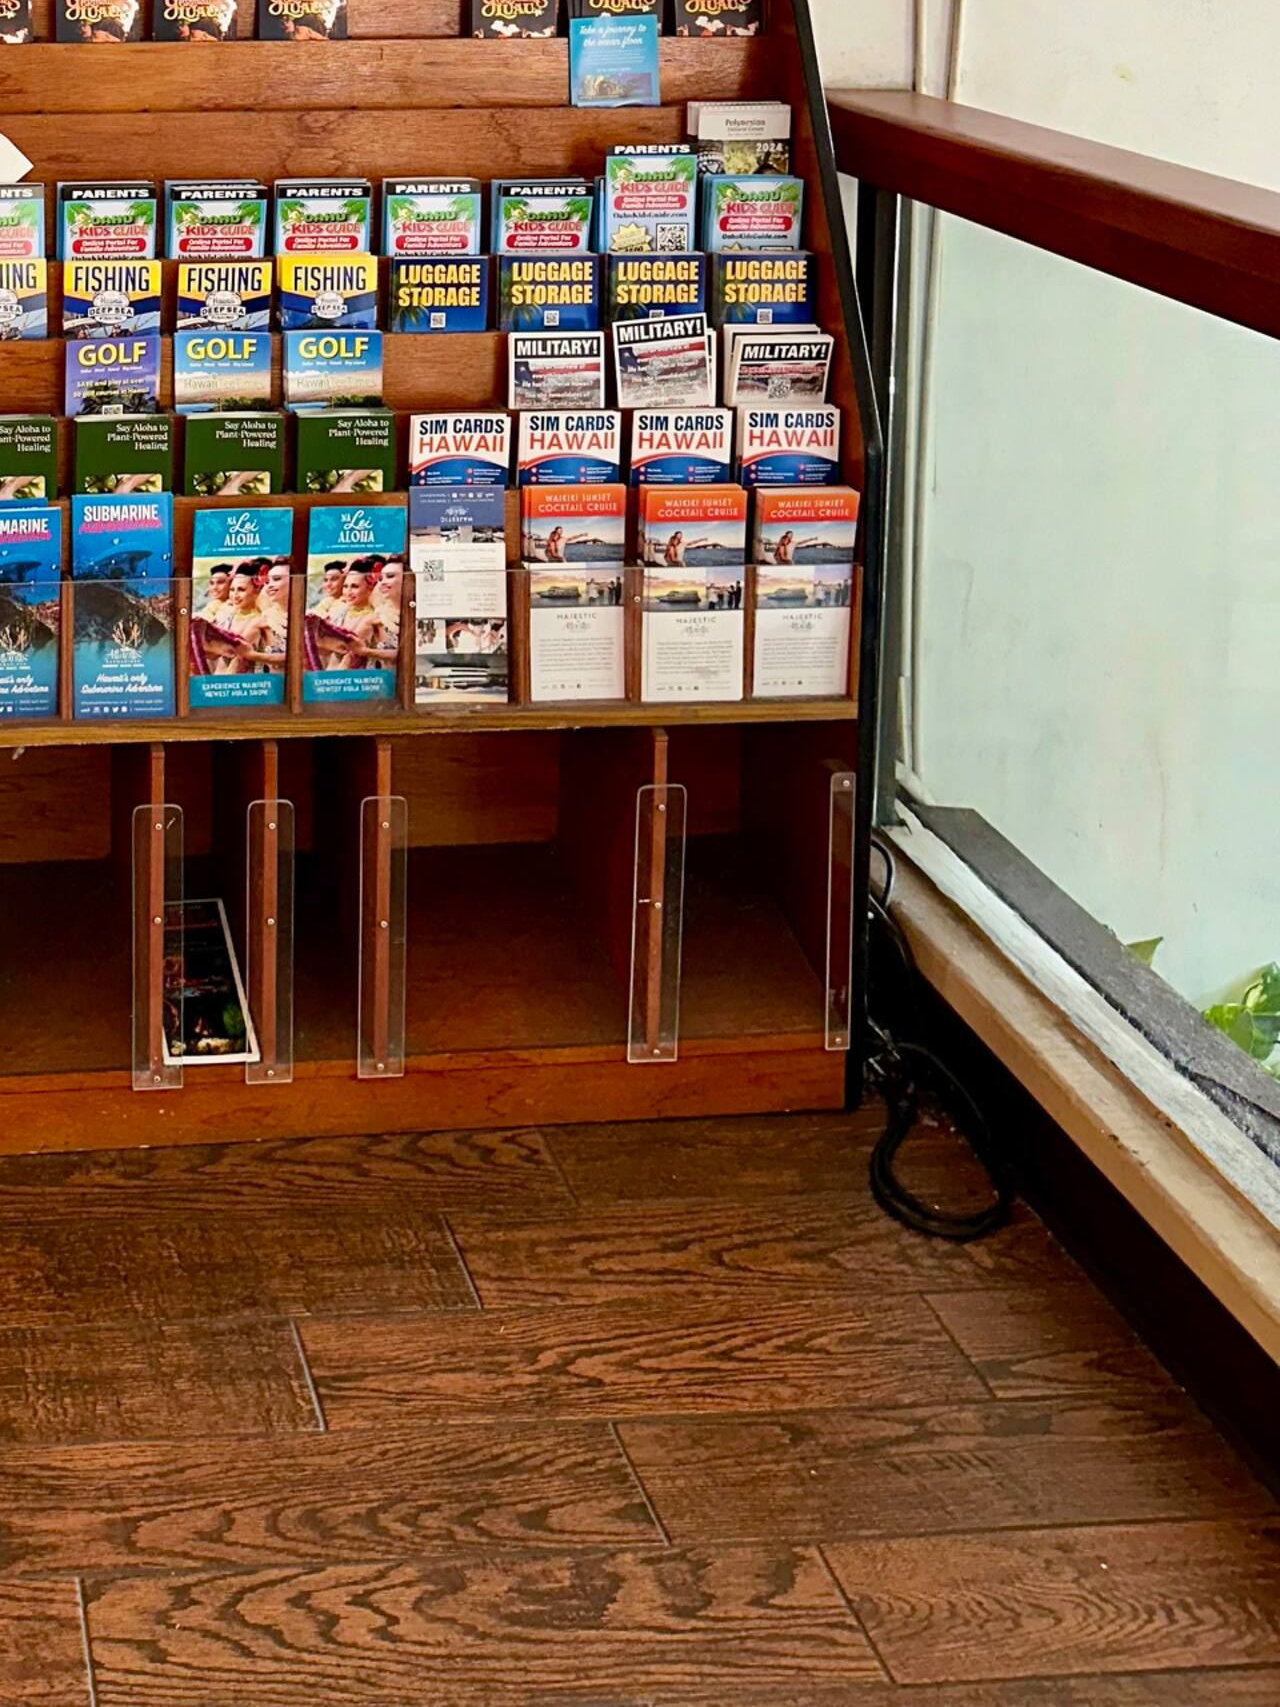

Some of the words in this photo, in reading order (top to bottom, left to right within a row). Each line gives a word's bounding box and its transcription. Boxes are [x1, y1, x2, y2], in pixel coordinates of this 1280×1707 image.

[725, 118, 767, 128] Polynesian
[614, 144, 691, 155] PARENTS
[756, 142, 784, 153] 2024
[286, 187, 363, 198] PARENTS
[395, 183, 472, 194] PARENTS
[510, 186, 587, 196] PARENTS
[620, 182, 652, 194] KIDS
[654, 181, 690, 193] GUIDE
[72, 188, 150, 200] PARENTS
[180, 190, 258, 200] PARENTS
[726, 202, 757, 214] KIDS
[759, 202, 795, 214] GUIDE
[79, 225, 111, 237] KIDS
[185, 225, 218, 236] KIDS
[219, 225, 255, 236] GUIDE
[291, 223, 323, 234] KIDS
[325, 222, 360, 233] GUIDE
[401, 221, 434, 233] KIDS
[436, 221, 470, 233] GUIDE
[513, 221, 546, 233] KIDS
[547, 221, 582, 232] GUIDE
[399, 264, 481, 284] LUGGAGE
[511, 261, 594, 282] LUGGAGE
[617, 261, 699, 281] LUGGAGE
[725, 260, 808, 280] LUGGAGE
[73, 265, 150, 292] FISHING
[187, 266, 263, 293] FISHING
[293, 265, 366, 291] FISHING
[398, 286, 481, 307] STORAGE
[511, 284, 594, 305] STORAGE
[616, 283, 699, 304] STORAGE
[724, 282, 807, 303] STORAGE
[4, 304, 21, 314] SEA
[88, 305, 113, 315] DEEP
[114, 305, 132, 315] SEA
[202, 306, 225, 315] DEEP
[226, 306, 244, 315] SEA
[619, 318, 702, 343] MILITARY!
[186, 338, 257, 359] GOLF
[298, 337, 369, 359] GOLF
[516, 339, 598, 356] MILITARY!
[743, 344, 826, 360] MILITARY!
[78, 341, 147, 367] GOLF
[224, 421, 239, 431] Say
[240, 420, 266, 430] Aloha
[267, 421, 277, 430] to
[337, 419, 353, 429] Say
[353, 419, 378, 428] Aloha
[380, 419, 389, 428] to
[529, 415, 559, 431] SIM
[565, 415, 615, 431] CARDS
[638, 415, 669, 431] SIM
[674, 414, 724, 431] CARDS
[748, 412, 779, 428] SIM
[784, 412, 835, 428] CARDS
[14, 425, 40, 434] Aloha
[41, 425, 51, 433] to
[116, 424, 132, 434] Say
[132, 423, 158, 432] Aloha
[159, 424, 168, 432] to
[419, 419, 447, 435] SIM
[452, 418, 505, 434] CARDS
[107, 432, 168, 442] Plant-Powered
[215, 430, 277, 439] Plant-Powered
[328, 428, 389, 438] Plant-Powered
[748, 429, 835, 447] HAWAII
[134, 442, 169, 452] Healing
[242, 439, 277, 449] Healing
[355, 437, 389, 447] Healing
[419, 434, 505, 454] HAWAII
[529, 432, 615, 450] HAWAII
[638, 432, 724, 450] HAWAII
[17, 443, 51, 453] Healing
[544, 493, 580, 503] WAIKIKI
[664, 498, 700, 508] WAIKIKI
[777, 499, 812, 508] WAIKIKI
[83, 504, 159, 523] SUBMARINE
[538, 503, 584, 513] COCKTAIL
[657, 508, 705, 518] COCKTAIL
[770, 509, 816, 519] COCKTAIL
[229, 512, 260, 534] Lei
[343, 509, 372, 531] Lei
[223, 533, 261, 547] ALOHA
[337, 530, 375, 543] ALOHA
[556, 612, 597, 620] MAJESTIC
[675, 616, 717, 625] MAJESTIC
[782, 613, 823, 621] MAJESTIC
